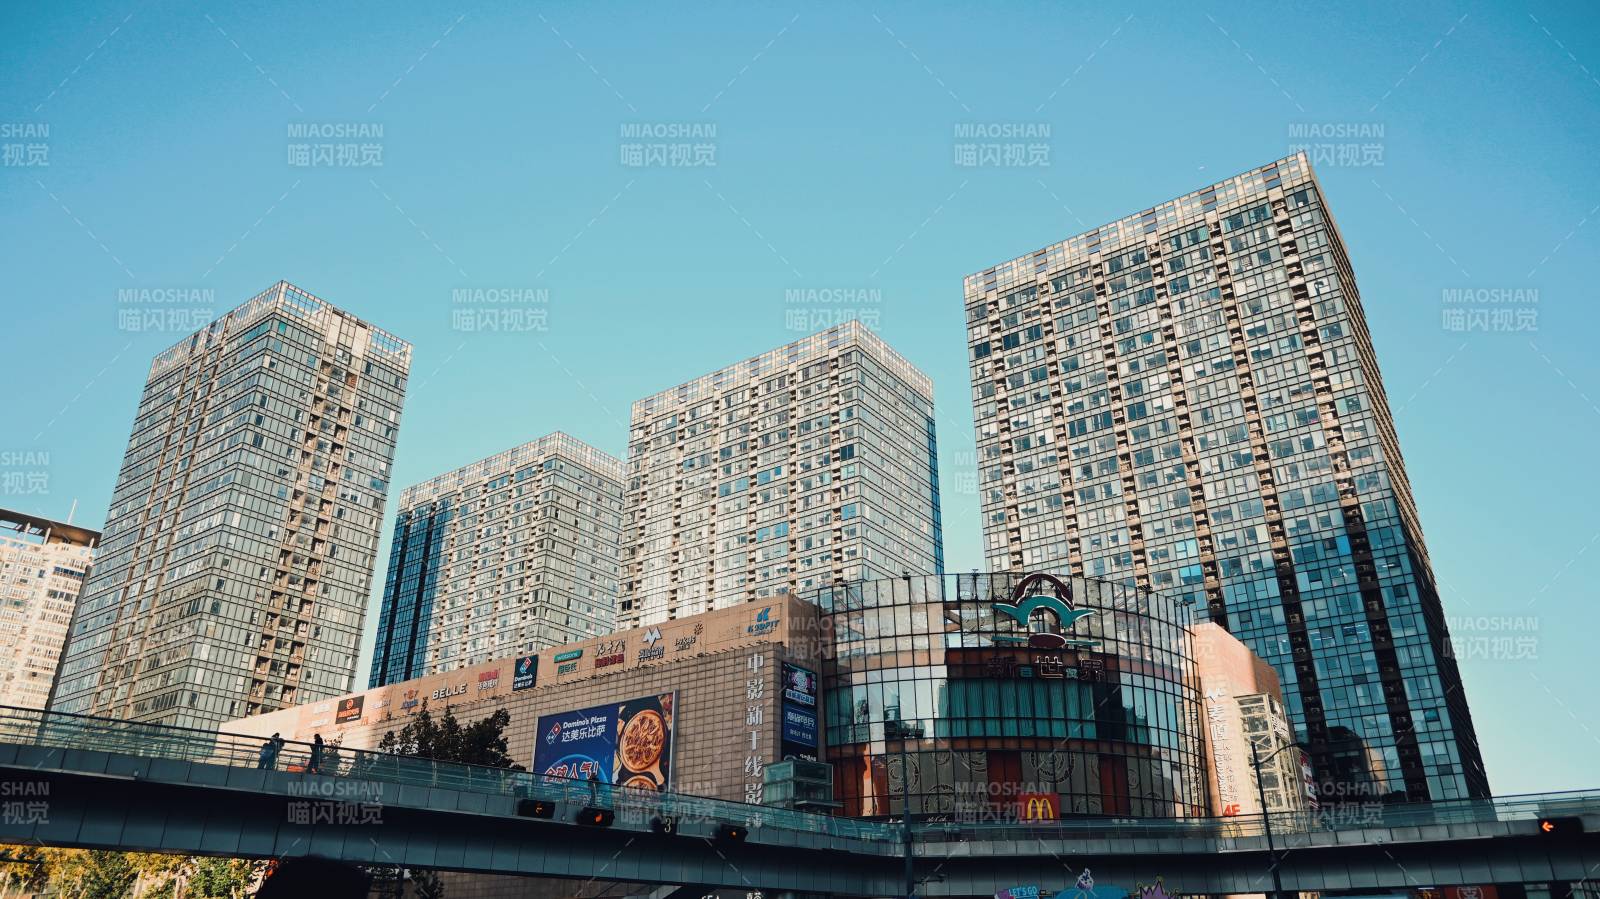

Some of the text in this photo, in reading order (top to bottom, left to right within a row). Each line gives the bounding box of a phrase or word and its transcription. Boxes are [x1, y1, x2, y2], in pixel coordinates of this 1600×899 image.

[432, 683, 467, 700] BELLE
[563, 716, 607, 728] Domino's Pizza
[561, 725, 606, 743] 达美乐比萨
[664, 817, 672, 833] 3
[1027, 886, 1038, 895] GO
